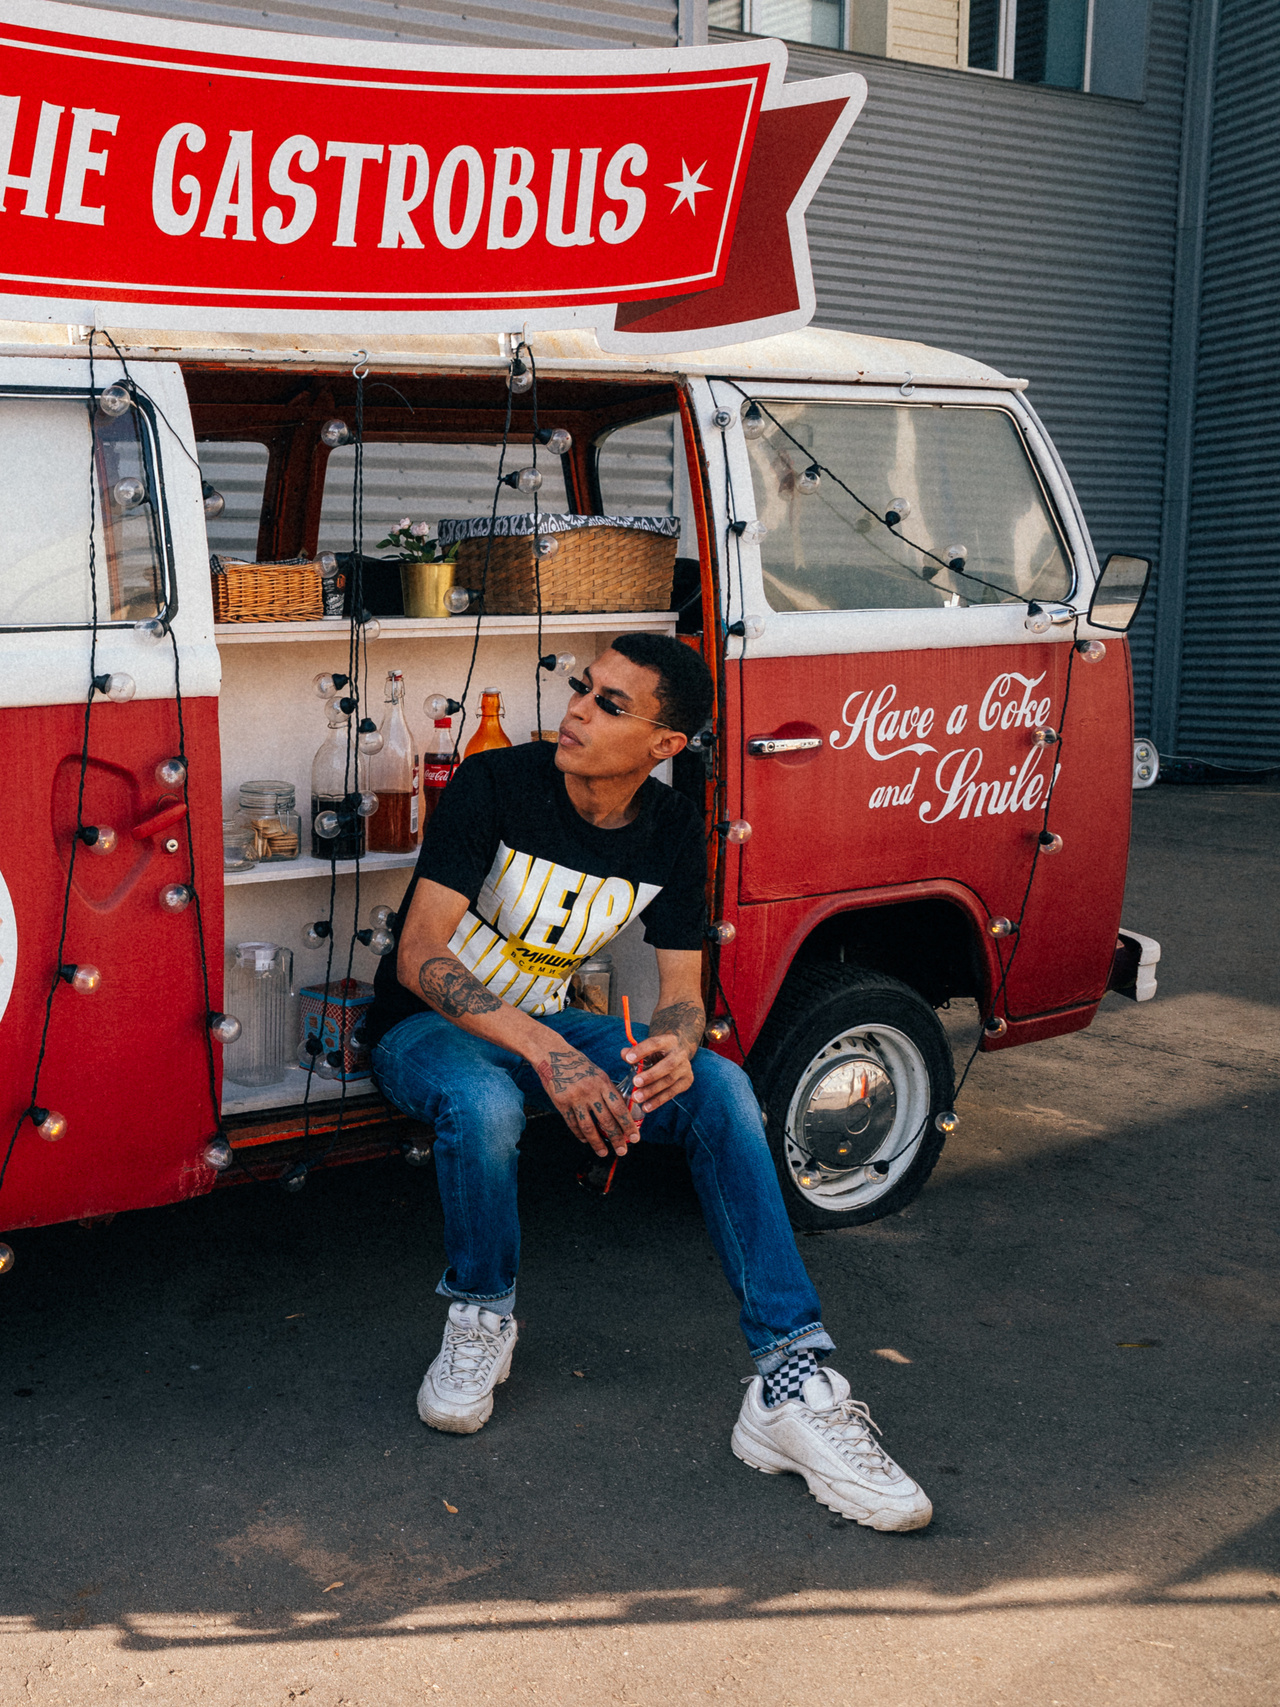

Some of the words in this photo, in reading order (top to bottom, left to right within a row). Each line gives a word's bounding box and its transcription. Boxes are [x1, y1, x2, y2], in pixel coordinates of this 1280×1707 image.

[152, 122, 648, 250] GASTROBUS
[829, 684, 938, 761] Have
[946, 704, 968, 735] a
[978, 670, 1051, 731] Coke
[868, 767, 921, 809] and
[918, 745, 1061, 824] Smile!
[516, 947, 587, 971] МИШК
